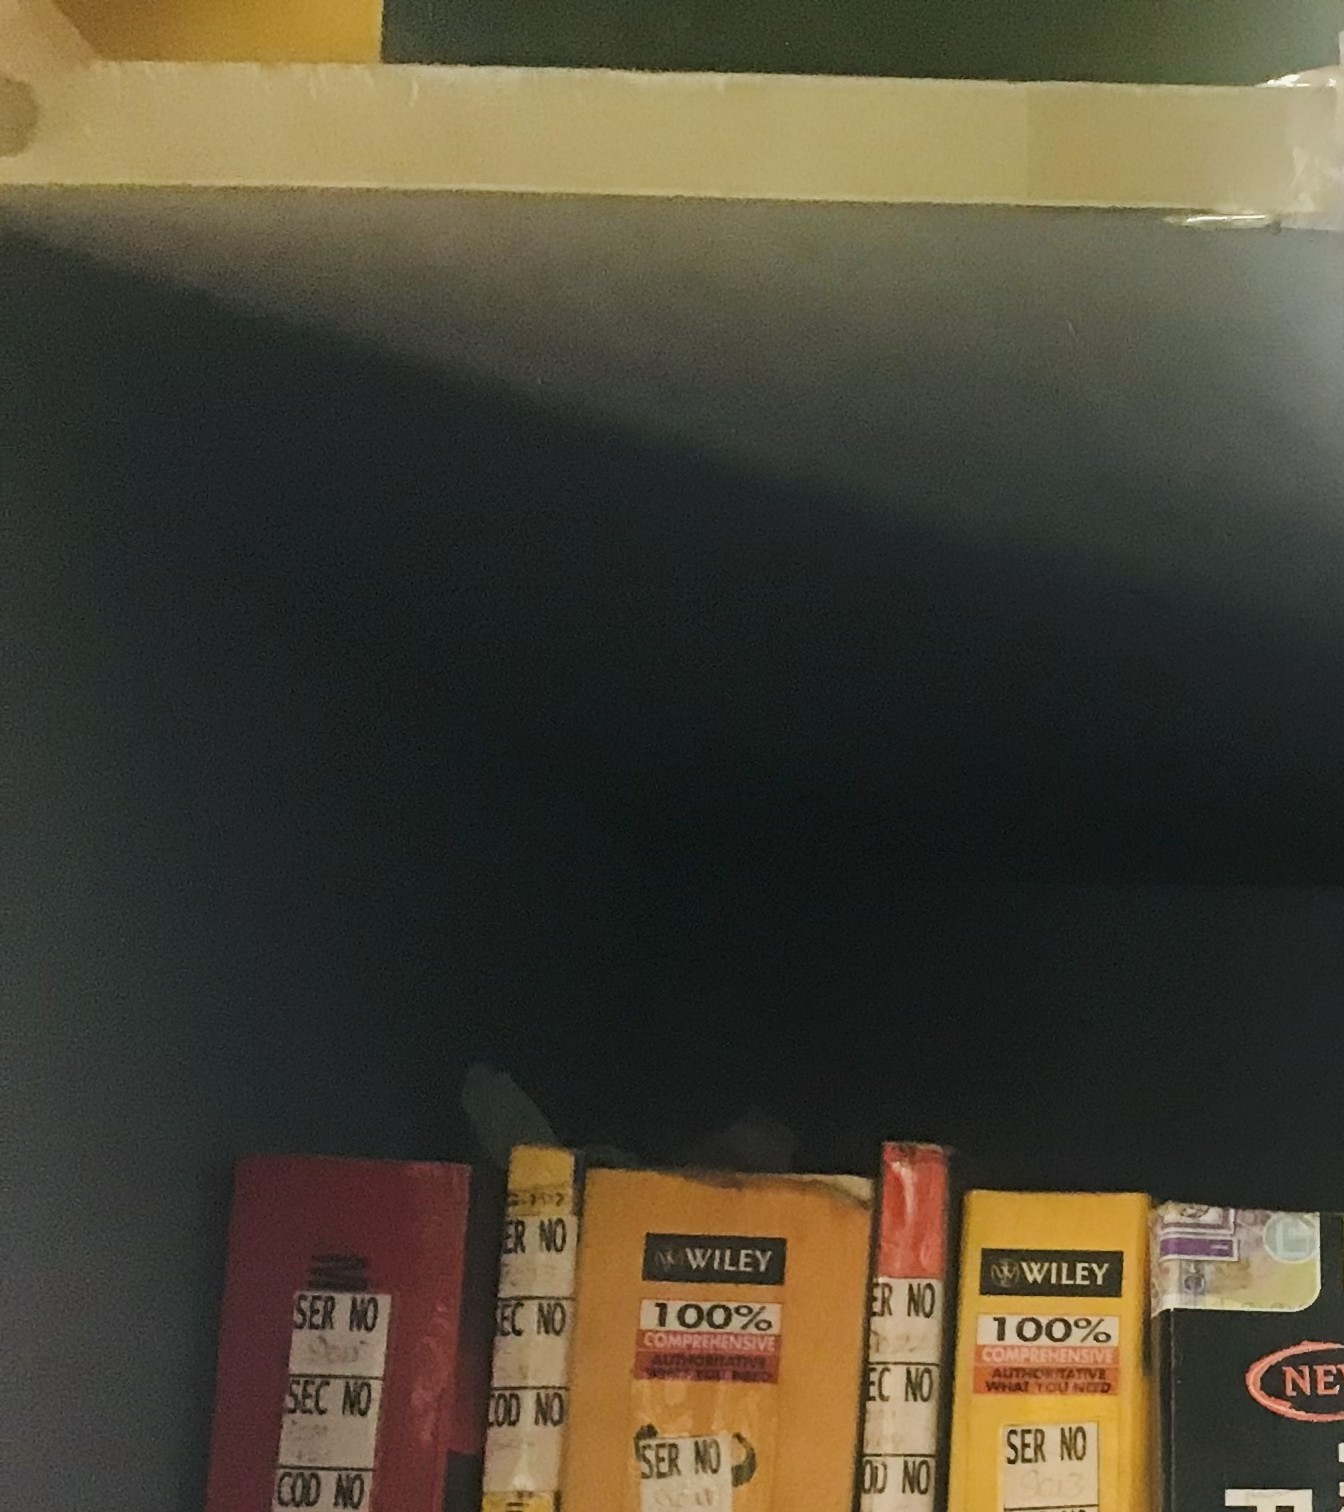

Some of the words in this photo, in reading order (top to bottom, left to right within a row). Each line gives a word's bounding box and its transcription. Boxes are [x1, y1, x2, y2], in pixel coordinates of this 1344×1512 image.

[1021, 1260, 1109, 1285] WILEY
[295, 1296, 335, 1330] SER
[351, 1298, 378, 1329] NO
[653, 1303, 773, 1331] 100%
[990, 1316, 1112, 1342] 100%
[981, 1348, 1114, 1364] COMPREHENSIVE
[289, 1381, 331, 1414] SEC
[342, 1382, 372, 1416] NO
[278, 1473, 318, 1506] COD
[336, 1475, 364, 1508] NO
